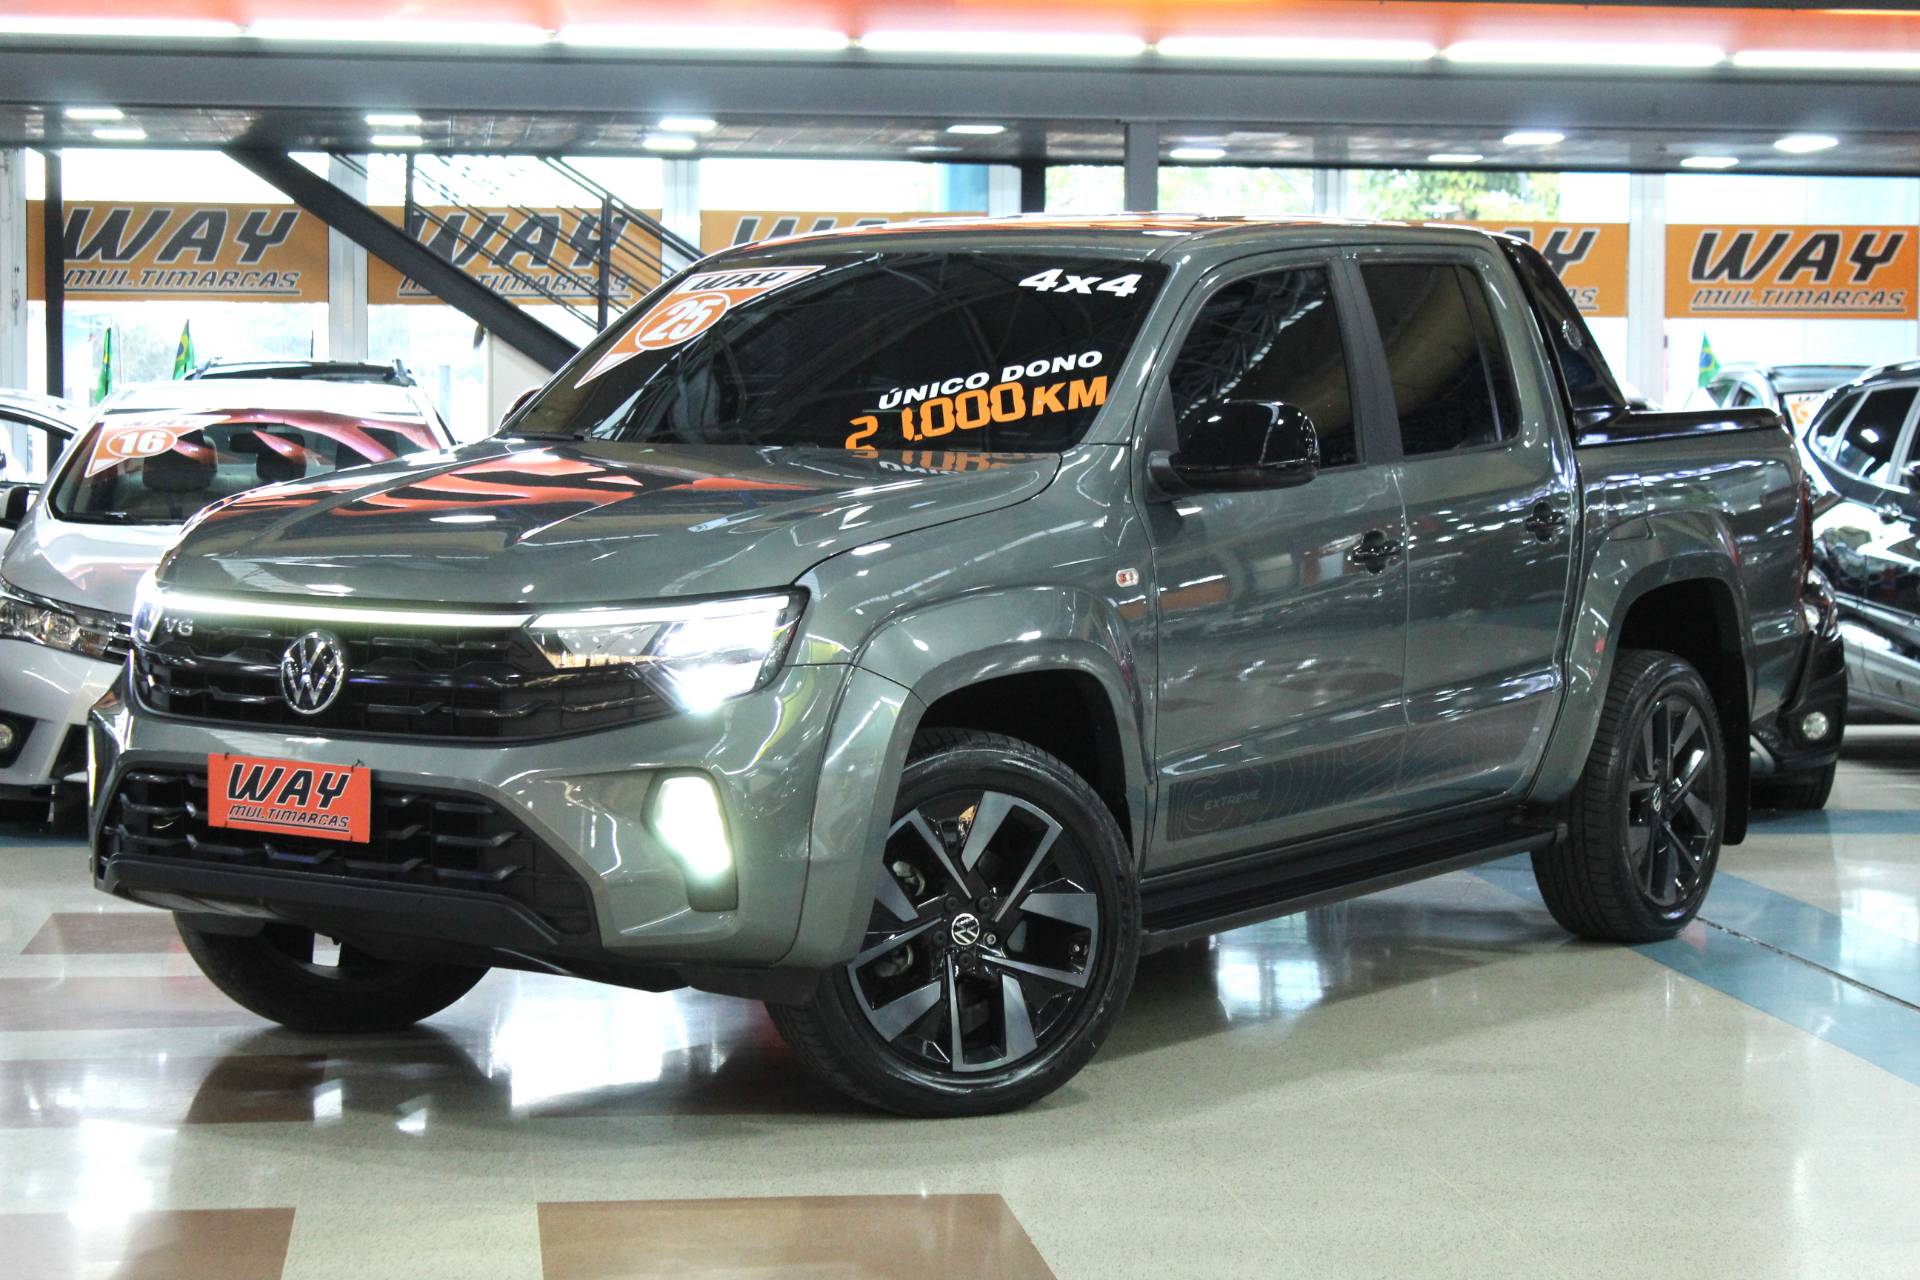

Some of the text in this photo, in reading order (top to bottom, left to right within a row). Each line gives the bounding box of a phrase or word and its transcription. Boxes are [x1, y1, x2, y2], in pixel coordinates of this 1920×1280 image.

[63, 207, 299, 264] WAY
[1689, 229, 1908, 283] WAY
[63, 269, 301, 290] MULTIMARCAS
[689, 272, 787, 292] WAY
[1017, 268, 1143, 298] 4x4
[1690, 288, 1906, 307] MULTIMARCAS
[639, 298, 724, 341] 25
[878, 350, 1103, 411] ÚNICO DONO
[1031, 375, 1108, 417] KM
[119, 431, 167, 454] 16
[227, 762, 352, 810] WAY
[229, 804, 350, 828] MULTIMARCAS
